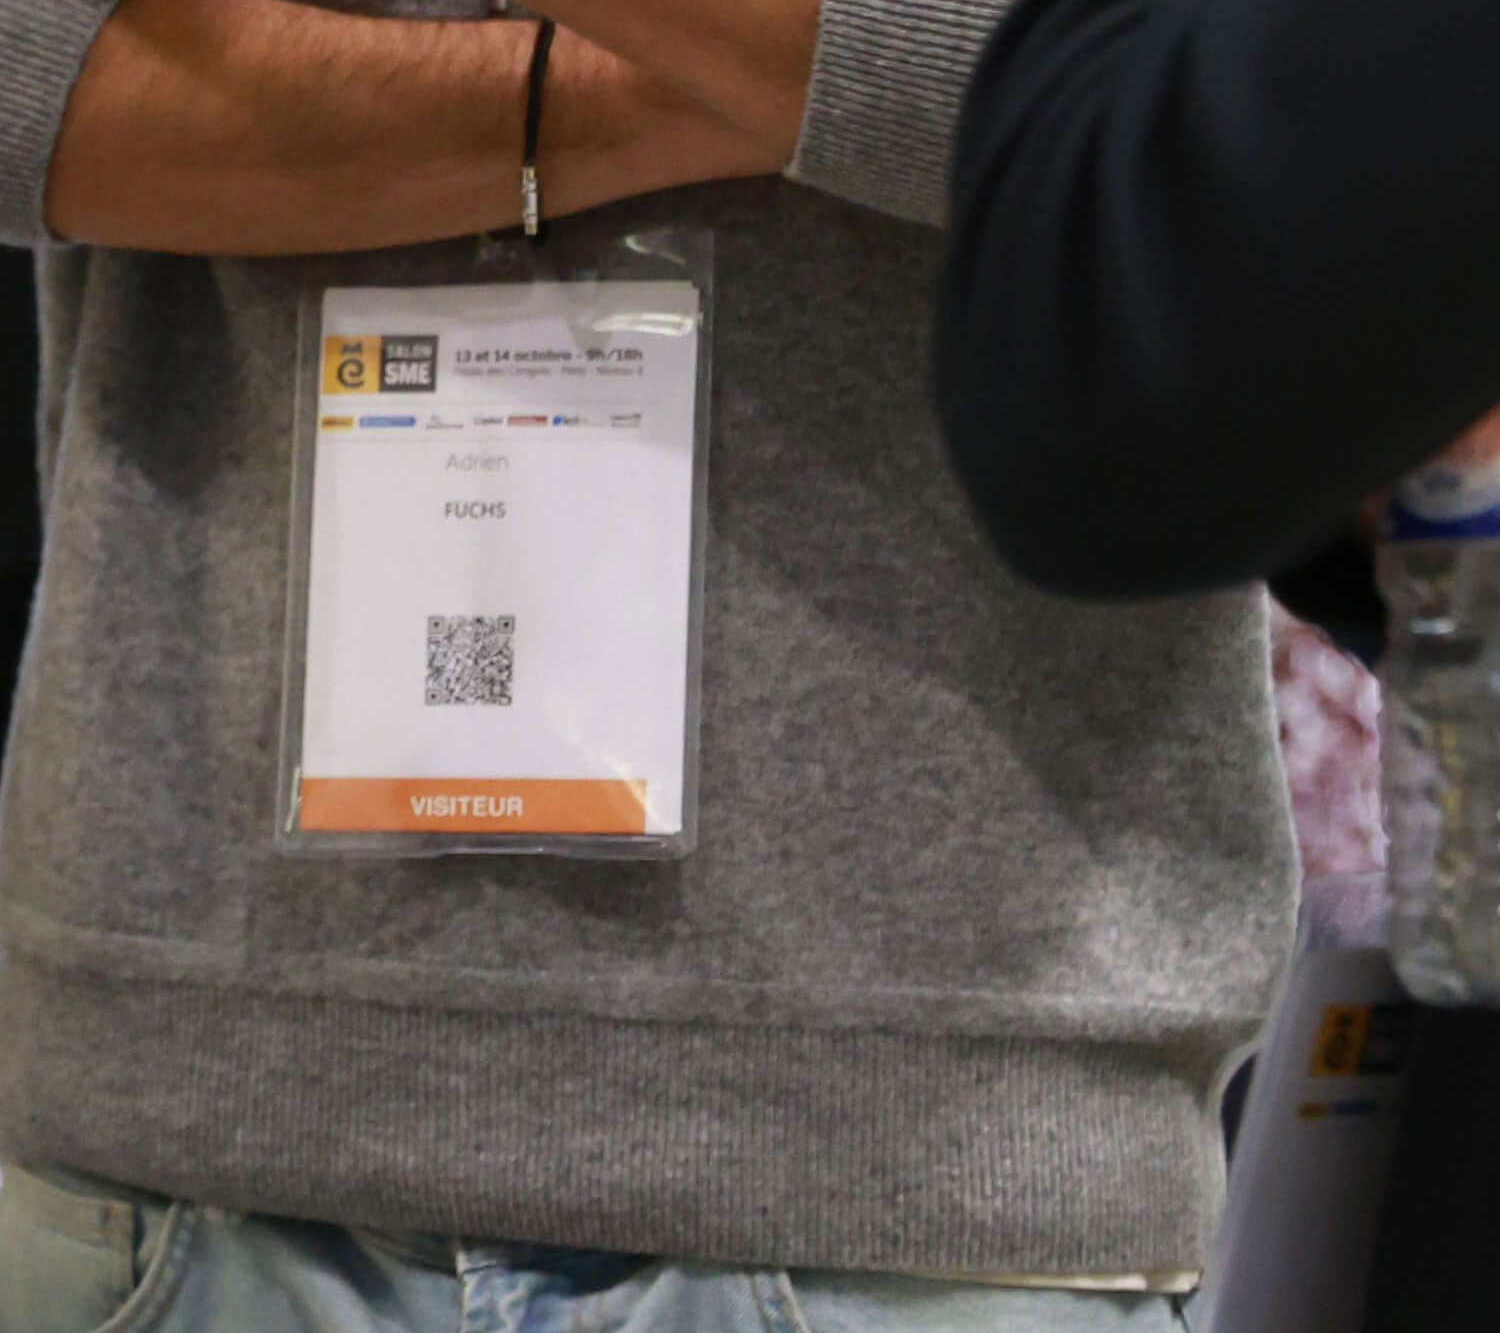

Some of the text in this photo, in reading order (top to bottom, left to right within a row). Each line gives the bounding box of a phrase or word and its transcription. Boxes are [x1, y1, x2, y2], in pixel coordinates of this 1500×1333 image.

[384, 362, 431, 385] SME
[445, 451, 509, 471] Adrien
[444, 500, 507, 519] FUCHS
[410, 795, 523, 817] VISITEUR
